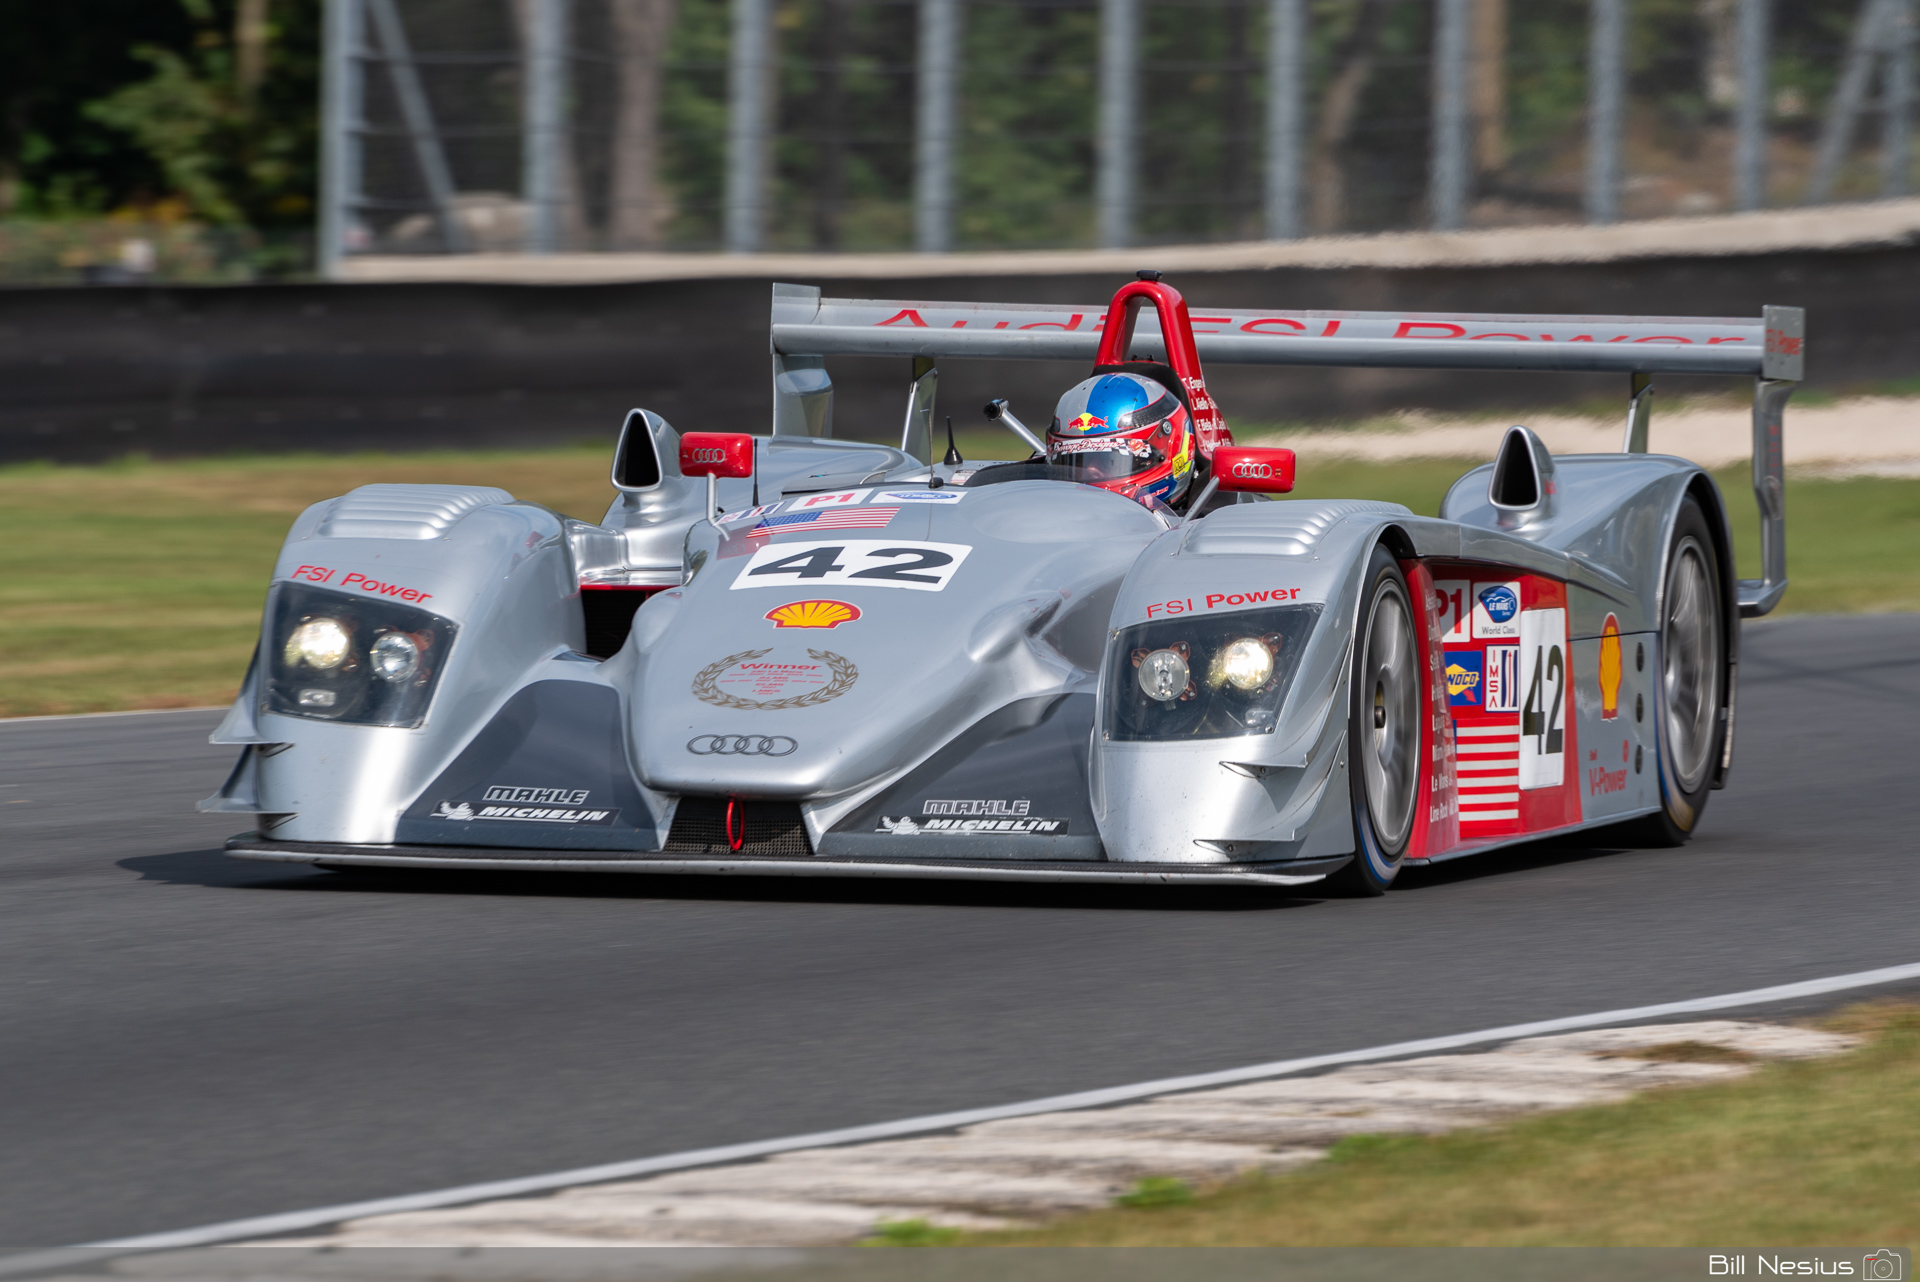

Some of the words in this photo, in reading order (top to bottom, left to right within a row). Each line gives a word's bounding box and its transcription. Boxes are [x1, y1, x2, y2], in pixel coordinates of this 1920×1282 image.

[803, 493, 856, 507] P1
[747, 546, 954, 584] 42
[291, 564, 337, 583] FSI
[339, 572, 433, 604] Power
[1146, 598, 1193, 618] FSI
[1206, 588, 1301, 608] Power
[1436, 588, 1462, 634] P1
[1482, 625, 1501, 635] World
[1503, 625, 1515, 634] Class
[740, 663, 822, 671] Winner
[1448, 673, 1478, 686] NOCO
[1522, 644, 1564, 755] 42
[1588, 766, 1627, 797] V-Power
[482, 785, 590, 805] MAHLE
[479, 806, 610, 822] MICHELIN
[922, 800, 1031, 815] MAHLE
[924, 819, 1060, 832] MICHELIN
